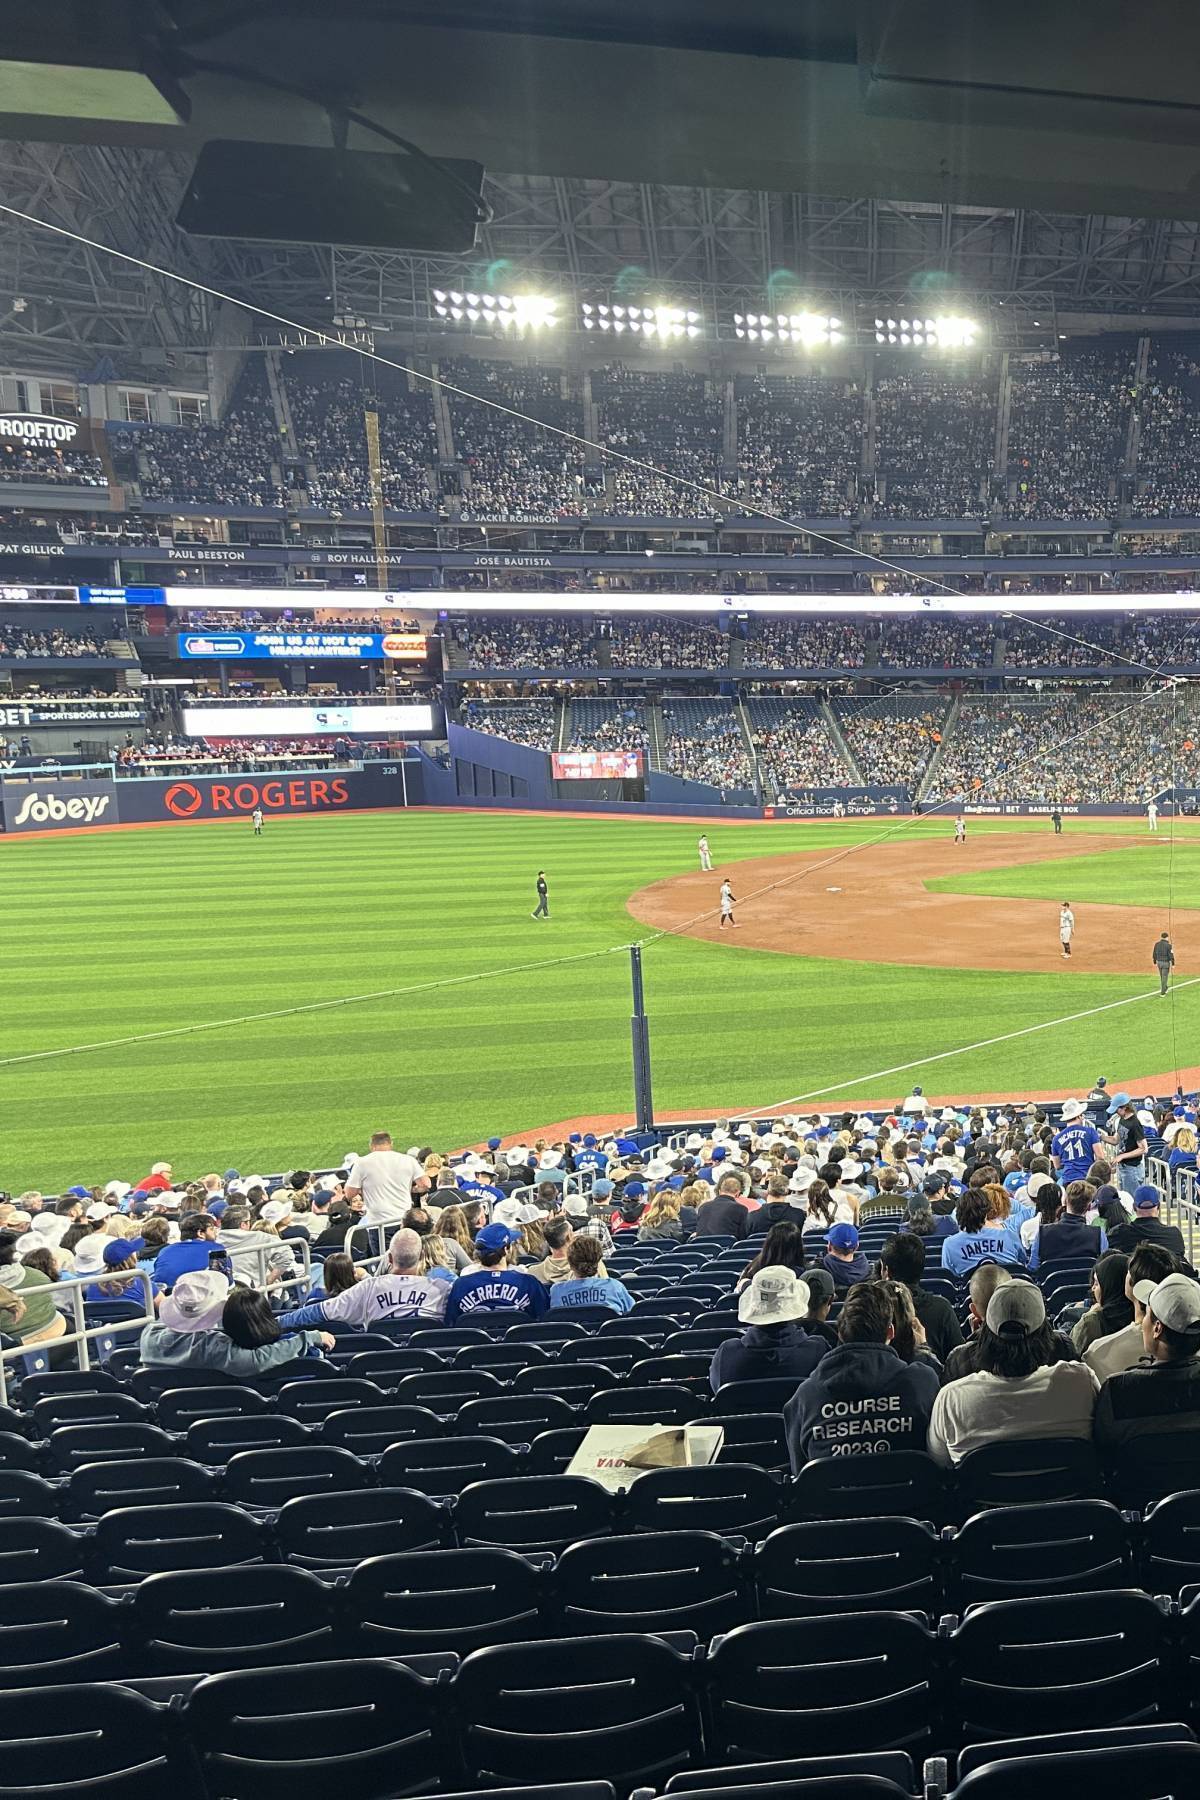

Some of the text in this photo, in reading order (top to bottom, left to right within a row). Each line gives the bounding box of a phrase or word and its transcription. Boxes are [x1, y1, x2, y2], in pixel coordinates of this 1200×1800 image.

[0, 420, 77, 441] ROOFTOP
[22, 438, 57, 448] PATIO
[474, 514, 508, 523] JACKIE
[509, 515, 559, 524] ROBINSON
[21, 545, 65, 555] GILLICK
[168, 550, 245, 560] PAUL BEESTON
[327, 555, 348, 563] ROY
[351, 555, 402, 564] HALLADAY
[504, 557, 552, 566] BAUTISTA
[287, 635, 303, 645] US
[305, 635, 320, 645] AT
[0, 708, 140, 725] BET SPORTSBOOK & CASINO
[382, 766, 398, 776] 328
[211, 779, 349, 810] ROGERS
[14, 793, 110, 825] Sobeys
[786, 806, 815, 815] Official
[847, 806, 876, 815] Shingle
[964, 805, 1001, 814] theScore
[1005, 805, 1020, 814] BET
[1063, 1138, 1086, 1161] 11
[960, 1239, 1004, 1260] JANSEN
[375, 1290, 428, 1310] PILLAR
[458, 1283, 520, 1311] GUERRERO
[820, 1395, 901, 1419] COURSE
[812, 1416, 913, 1441] RESEARCH
[831, 1441, 873, 1457] 2023
